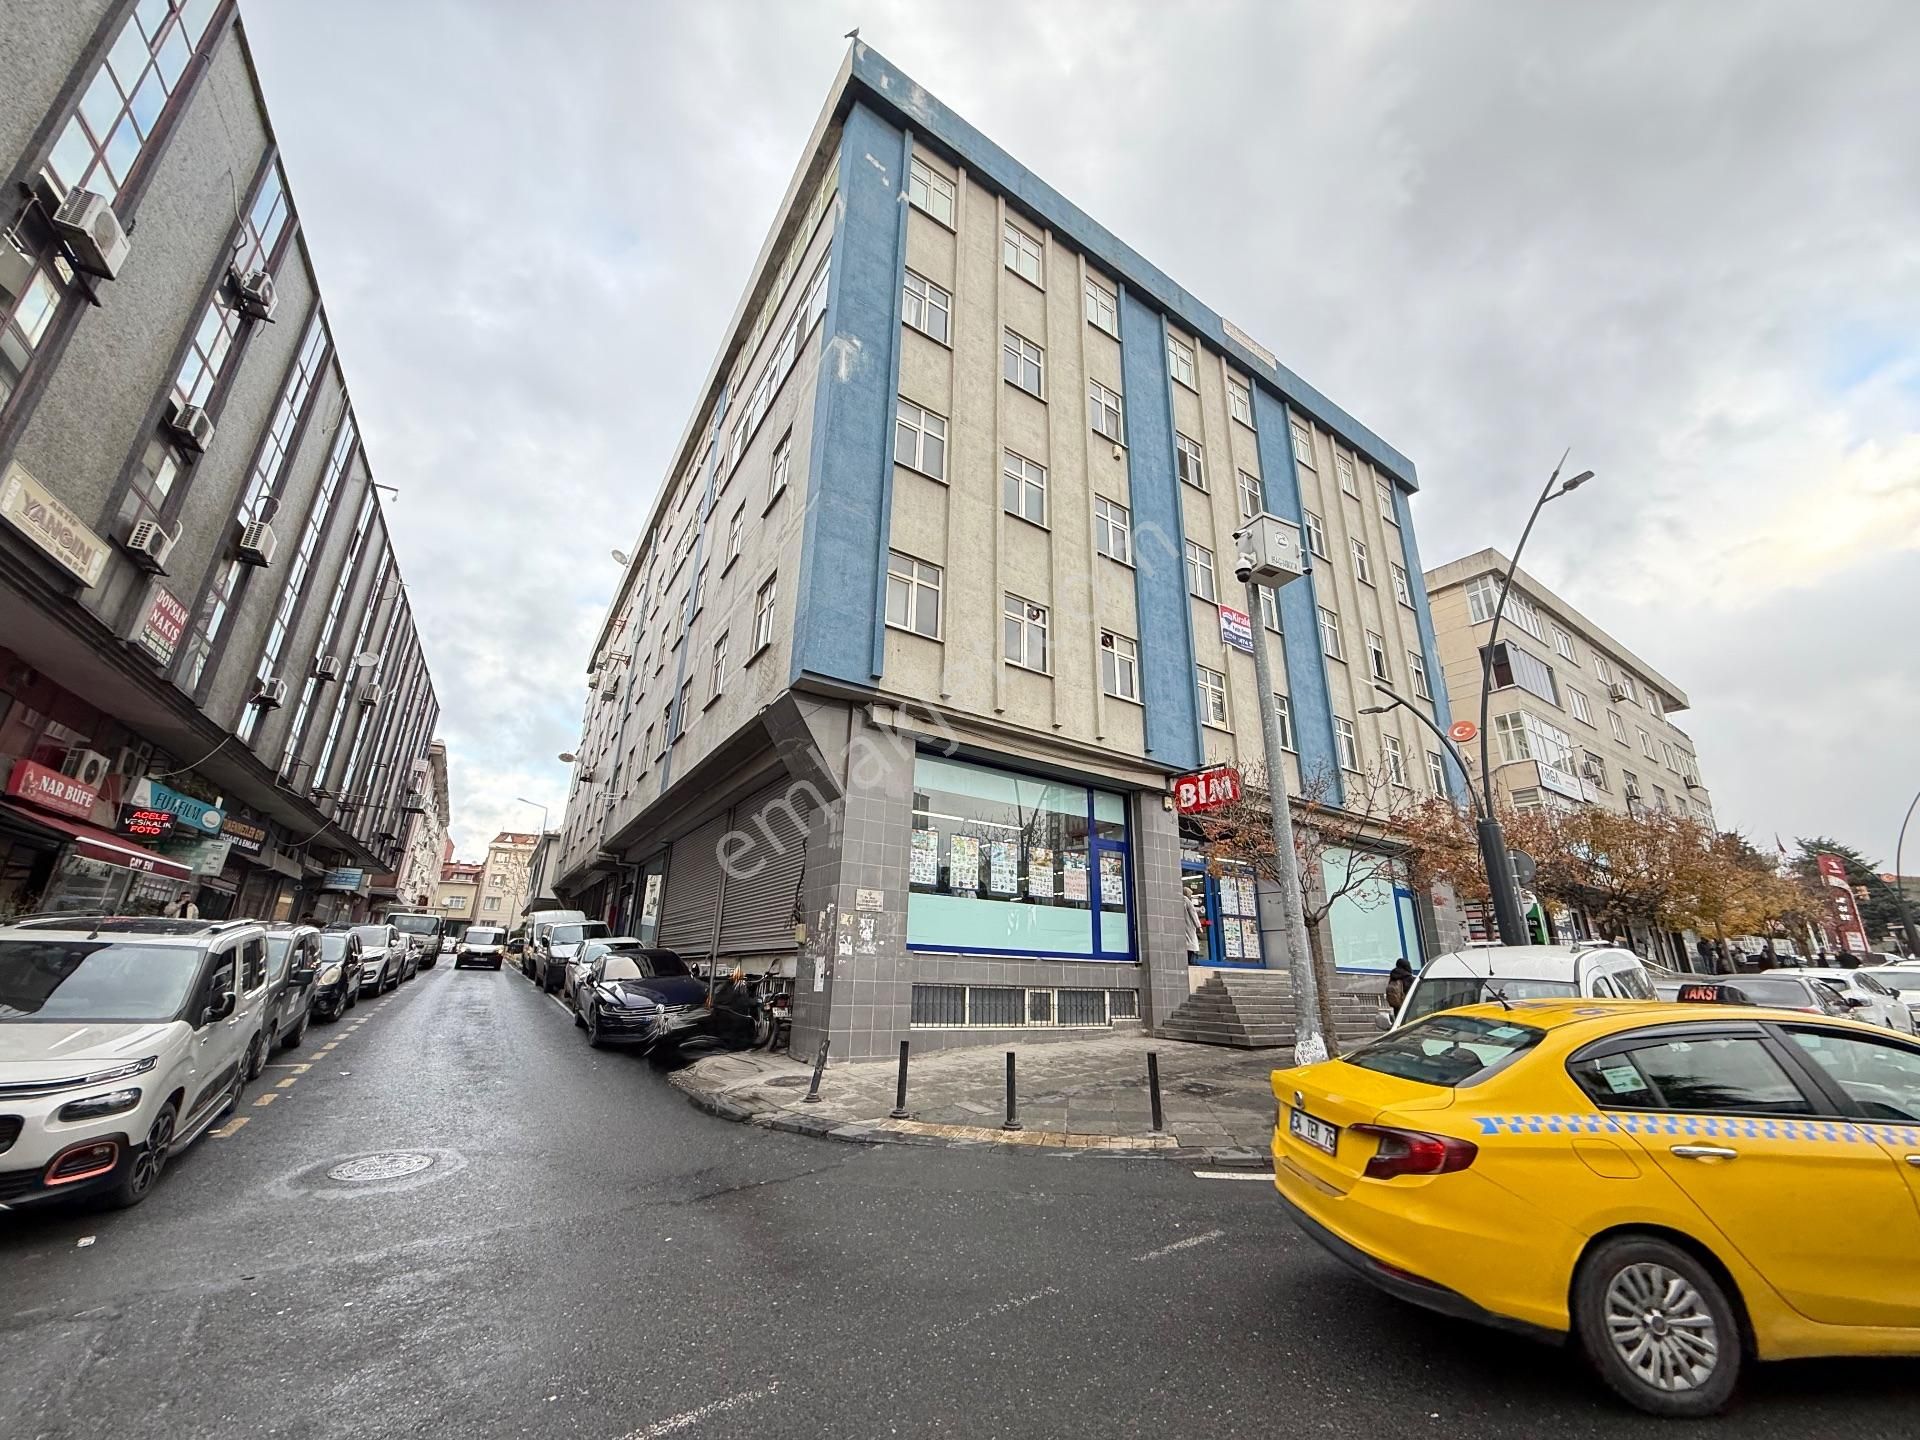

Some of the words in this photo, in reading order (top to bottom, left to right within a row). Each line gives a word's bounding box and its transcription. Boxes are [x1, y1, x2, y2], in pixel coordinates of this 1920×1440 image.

[23, 489, 92, 566] YANGIN
[157, 588, 189, 626] DOYSAN
[39, 775, 65, 798] NAR
[1179, 774, 1234, 808] BİM
[129, 825, 161, 835] FOTO
[132, 811, 170, 821] ACELE
